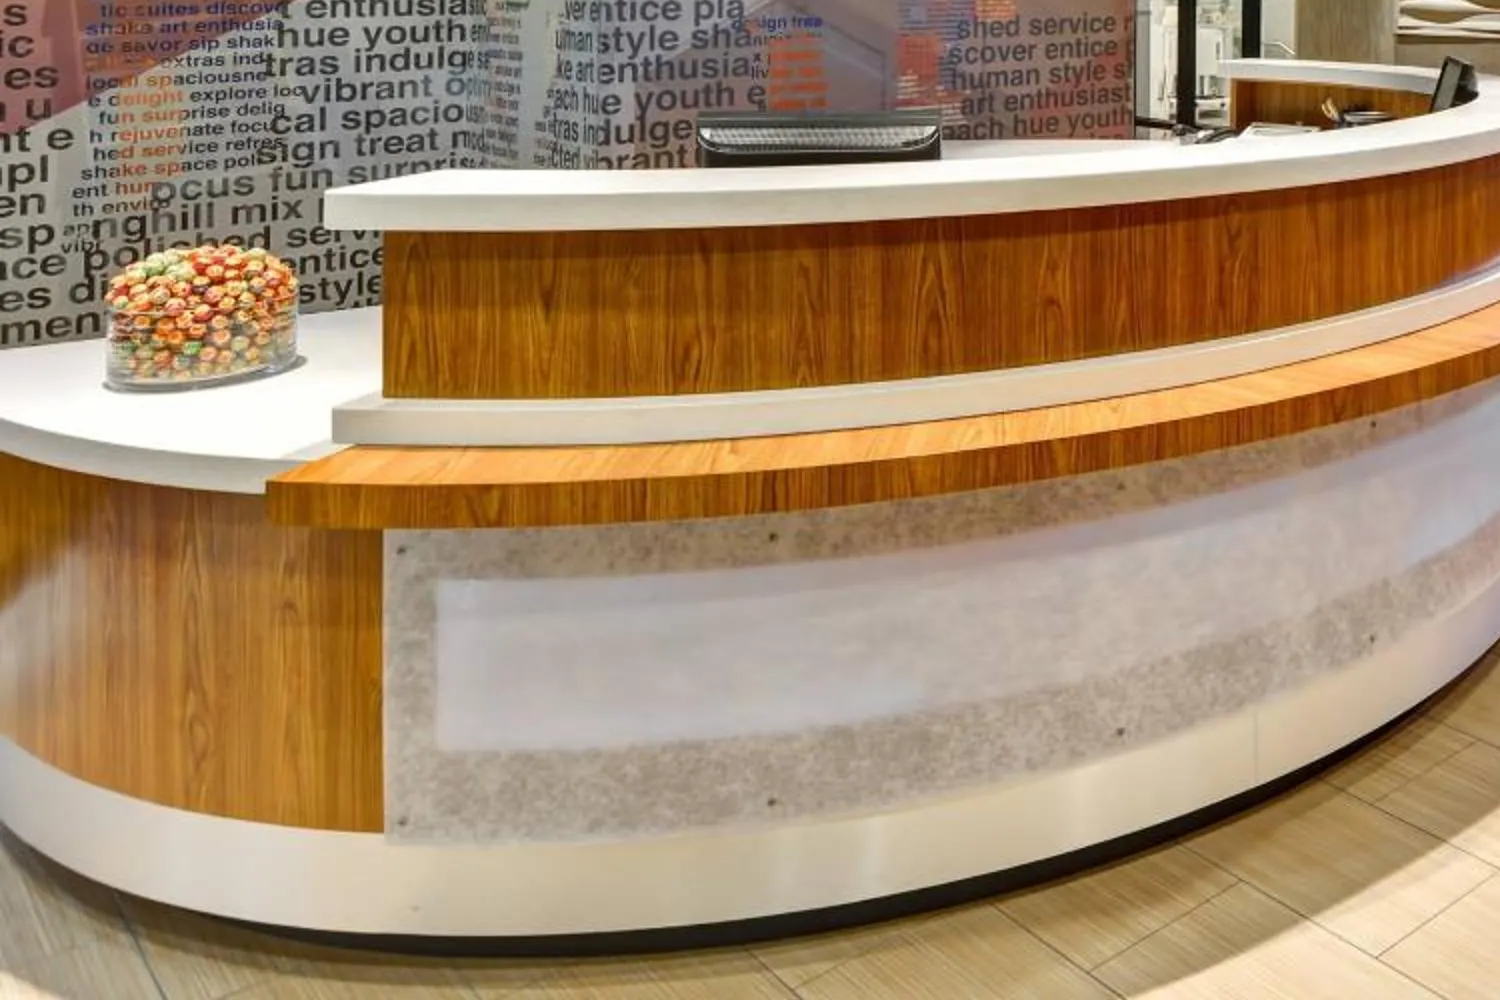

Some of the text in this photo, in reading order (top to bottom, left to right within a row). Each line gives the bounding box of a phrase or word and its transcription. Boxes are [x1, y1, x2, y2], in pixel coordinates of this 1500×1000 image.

[277, 19, 467, 52] hue youth
[1029, 11, 1117, 36] service
[189, 38, 220, 53] sip
[597, 24, 680, 60] style
[1044, 36, 1118, 61] entice
[354, 46, 474, 75] indulge
[598, 53, 750, 84] enthusia
[4, 66, 60, 90] es
[302, 73, 433, 104] vibrant
[952, 67, 1041, 92] human
[1048, 59, 1106, 89] style
[189, 84, 268, 104] explore
[634, 82, 735, 121] youth
[1004, 83, 1132, 113] enthusiast
[271, 106, 327, 135] cal
[583, 116, 694, 149] indulge
[1013, 114, 1060, 136] hue
[1067, 105, 1133, 140] youth
[142, 138, 219, 158] service
[354, 128, 440, 157] treat
[153, 156, 219, 177] space
[269, 166, 333, 195] fun
[231, 195, 303, 226] mix
[1, 311, 111, 345] men
